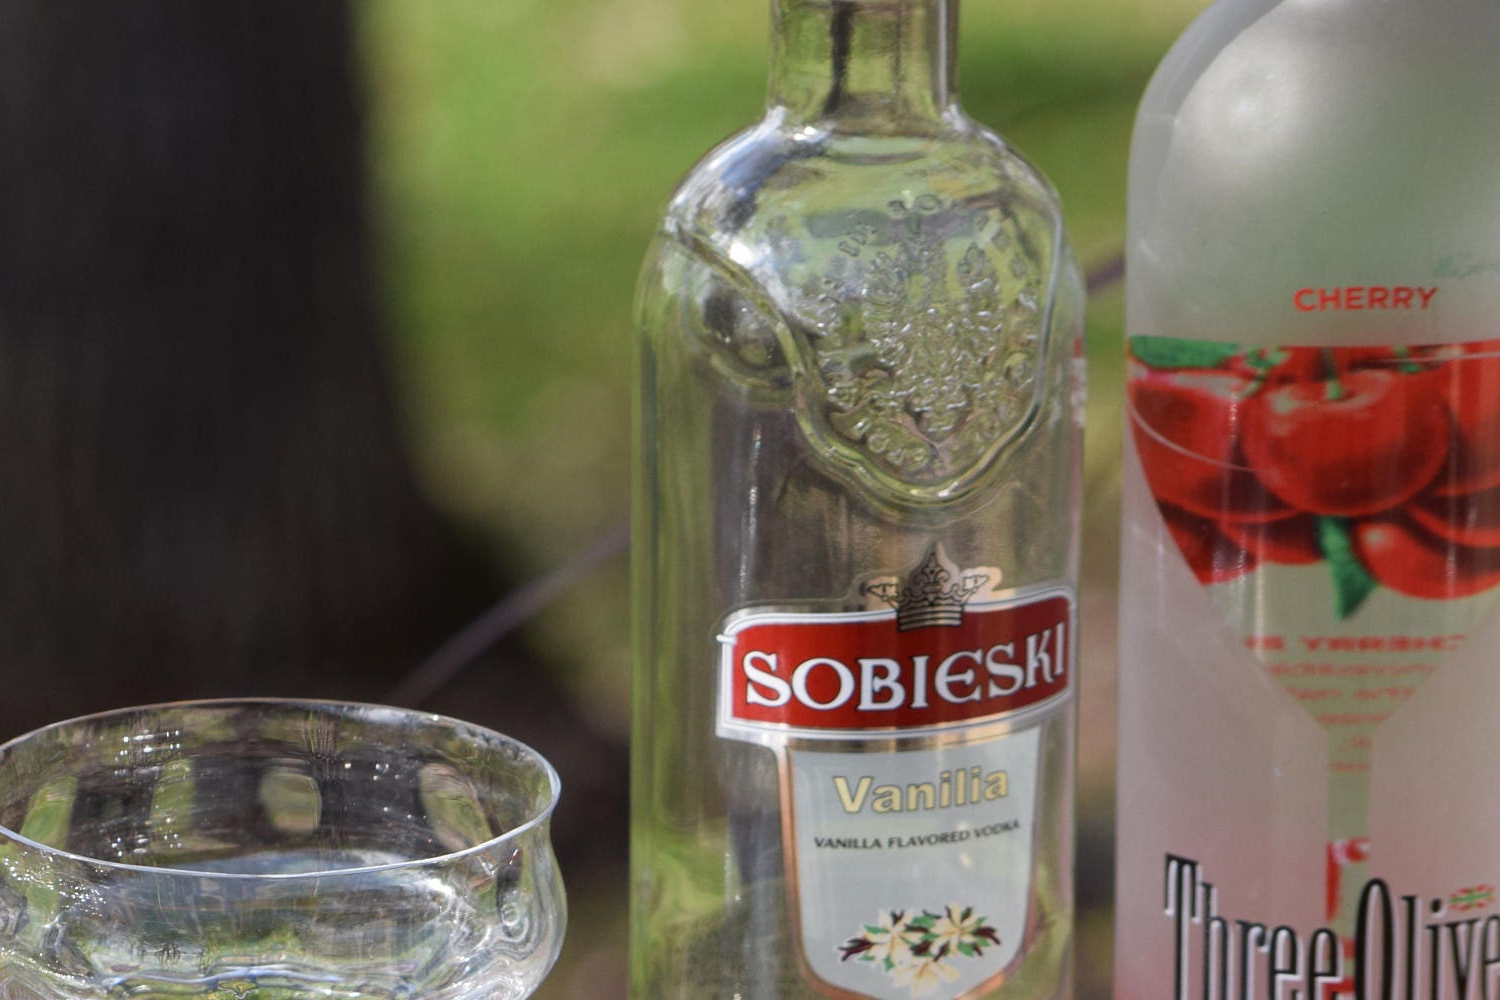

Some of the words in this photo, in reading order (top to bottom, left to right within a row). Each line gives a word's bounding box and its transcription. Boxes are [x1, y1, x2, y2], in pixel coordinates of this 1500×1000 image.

[1293, 286, 1438, 311] CHERRY
[743, 622, 1067, 711] SOBIESKI
[833, 765, 1009, 814] Vanilia
[814, 836, 882, 849] VANILLA
[888, 829, 970, 848] FLAVORED
[974, 818, 1020, 838] VODKA
